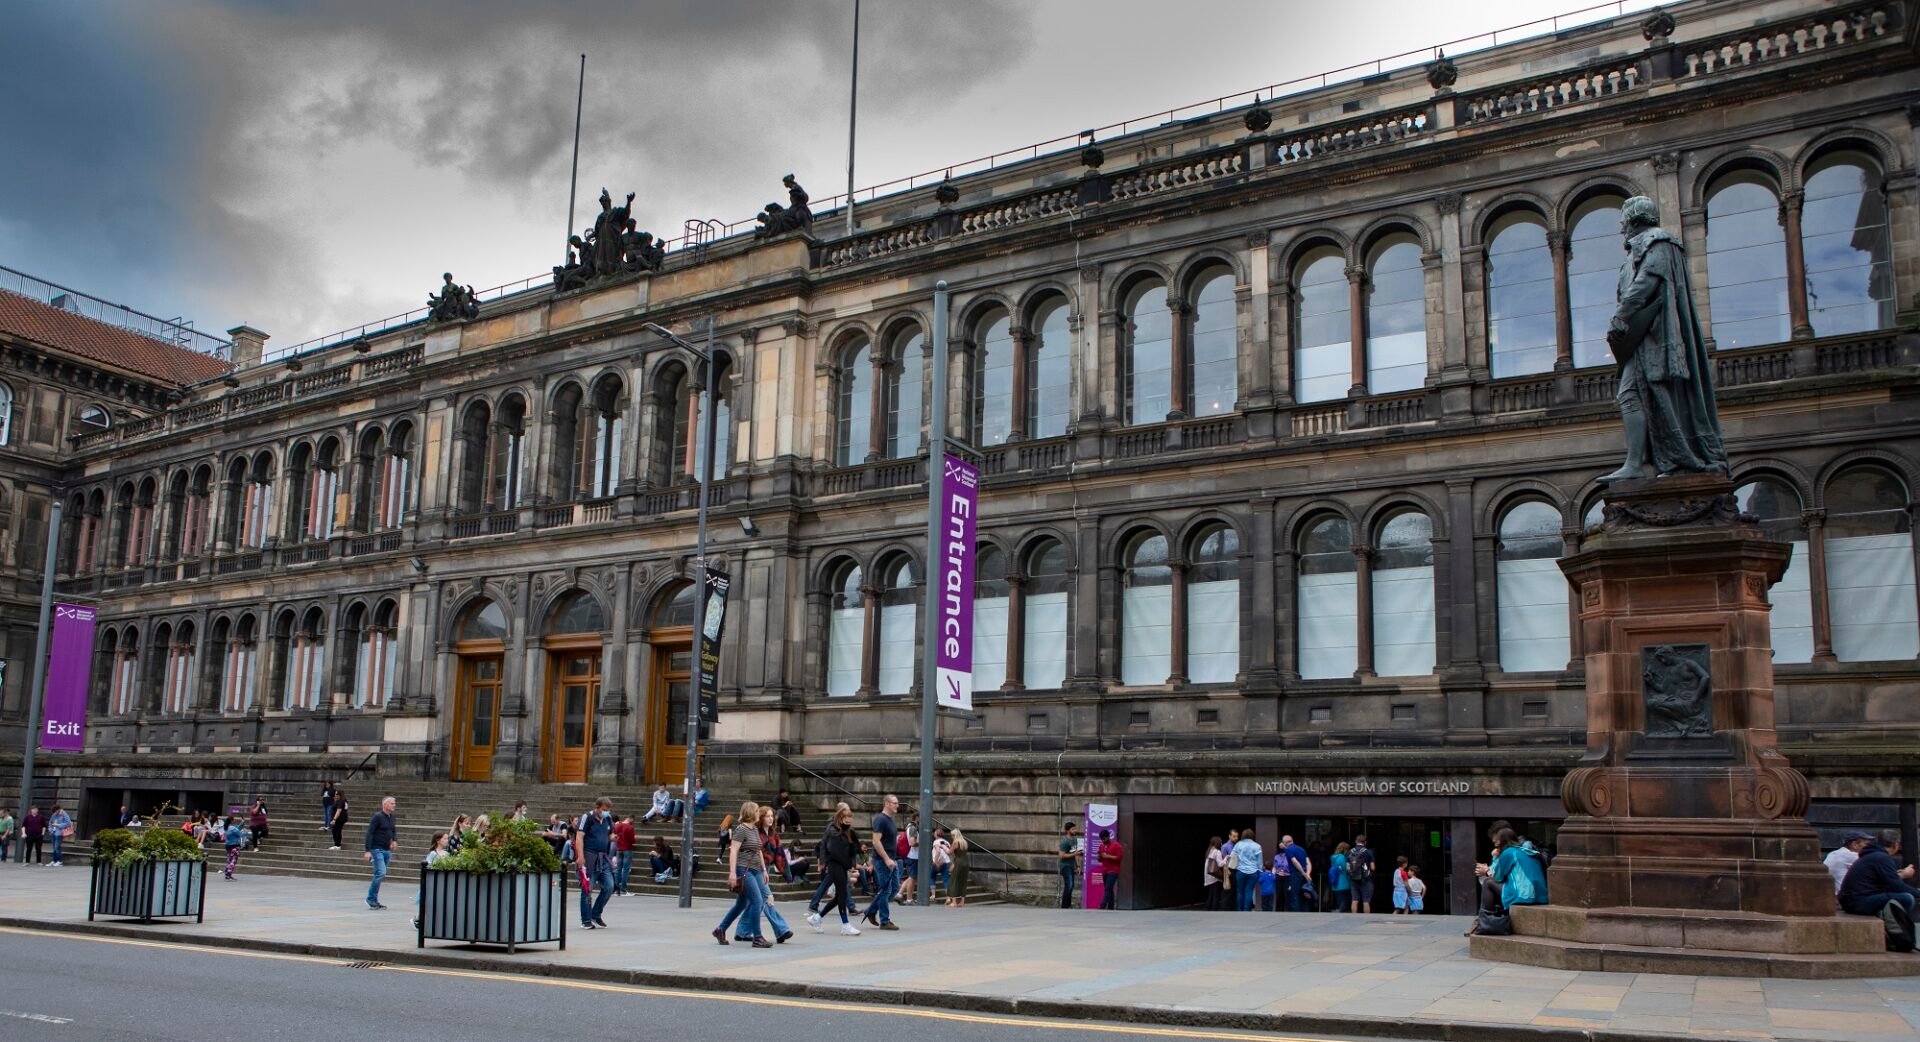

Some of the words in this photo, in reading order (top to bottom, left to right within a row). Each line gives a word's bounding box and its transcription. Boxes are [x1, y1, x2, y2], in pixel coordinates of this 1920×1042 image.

[945, 494, 970, 659] Entrance
[47, 719, 80, 736] Exit
[1255, 781, 1316, 792] NATIONAL
[1319, 781, 1376, 793] MUSEUM
[1379, 781, 1396, 793] OF
[1400, 781, 1470, 793] SCOTLAND
